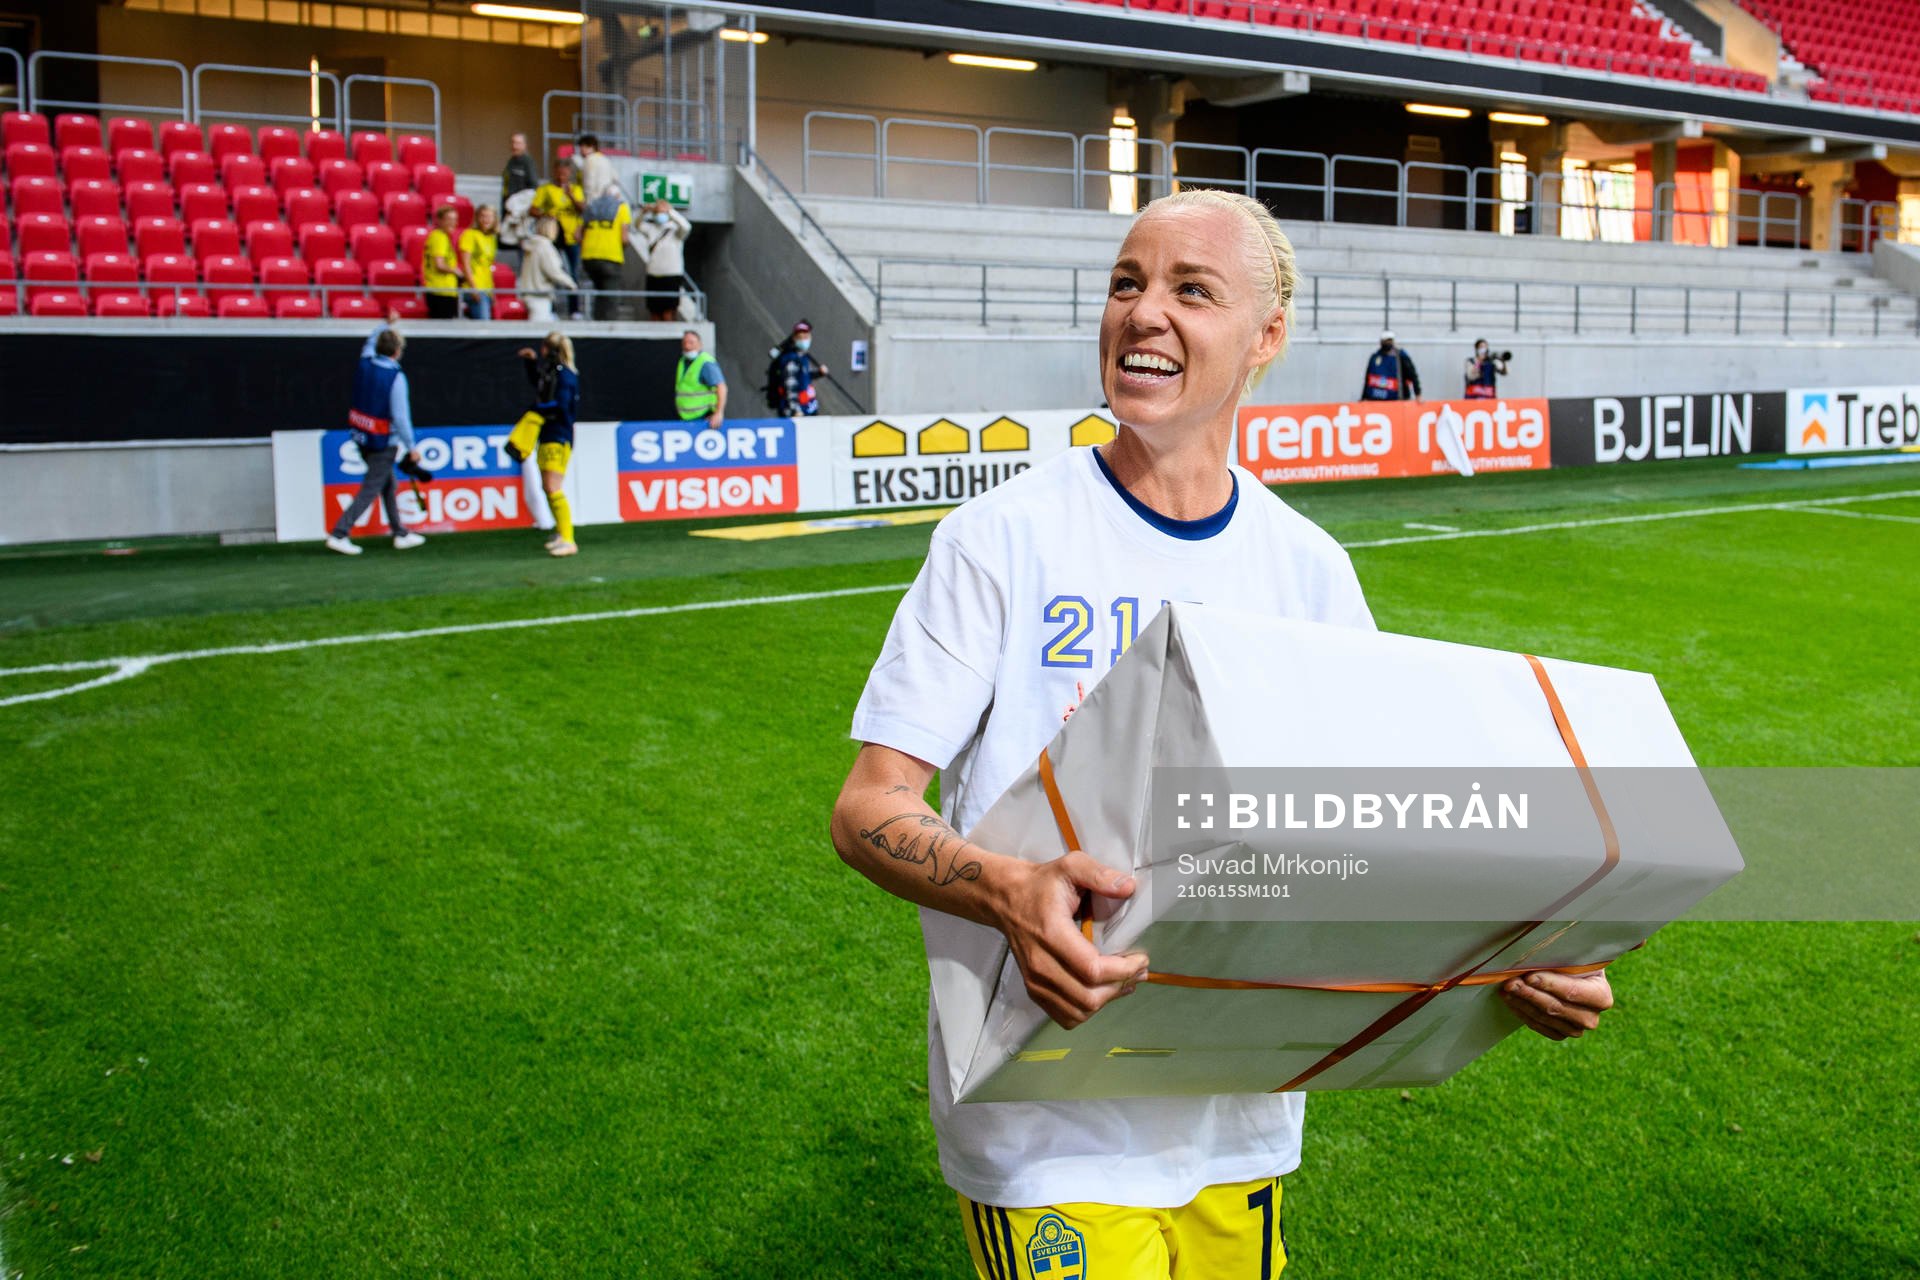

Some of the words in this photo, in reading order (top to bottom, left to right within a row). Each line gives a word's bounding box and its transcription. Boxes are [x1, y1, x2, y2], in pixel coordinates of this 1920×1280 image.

[1246, 405, 1392, 462] renta
[1418, 402, 1544, 454] rnta
[1594, 394, 1753, 462] BJELIN
[1837, 393, 1920, 446] Treb
[339, 435, 512, 475] SORT
[631, 427, 784, 463] SPORT
[628, 474, 783, 511] VISION
[1036, 1243, 1073, 1257] SVERIGE
